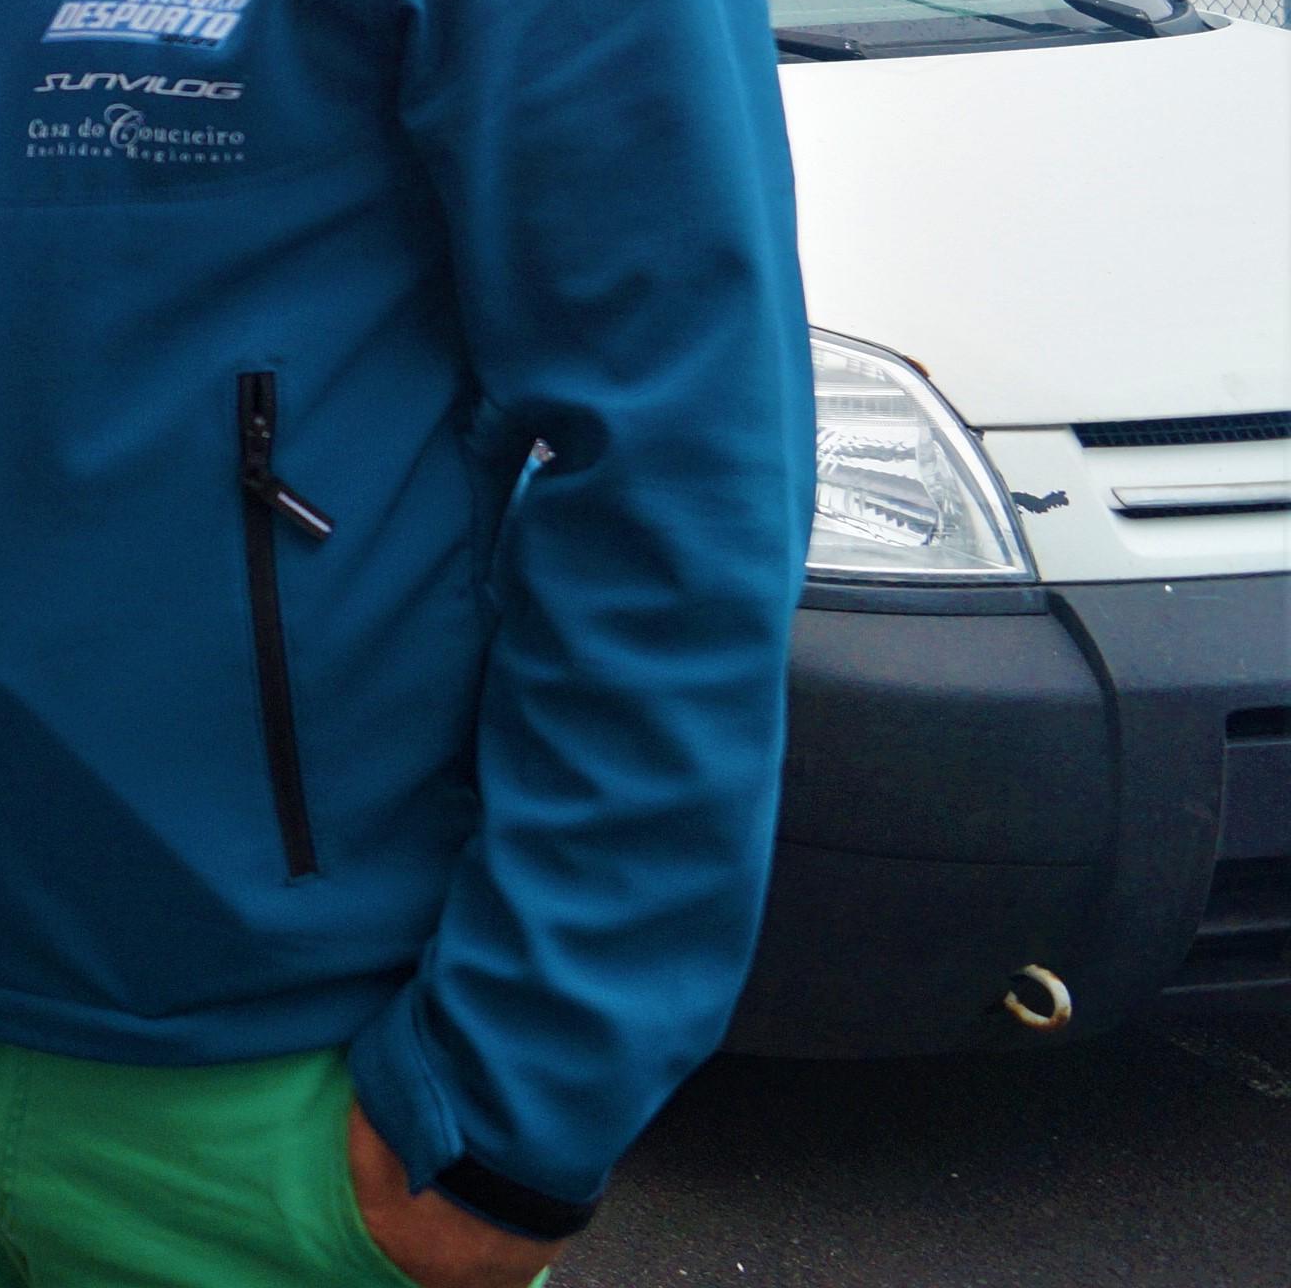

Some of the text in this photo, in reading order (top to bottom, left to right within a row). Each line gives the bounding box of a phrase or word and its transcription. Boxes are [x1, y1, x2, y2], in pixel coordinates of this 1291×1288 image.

[49, 1, 241, 39] DESPORTO
[33, 72, 244, 100] SUNVILOG
[28, 118, 70, 139] Casa
[78, 117, 106, 138] do
